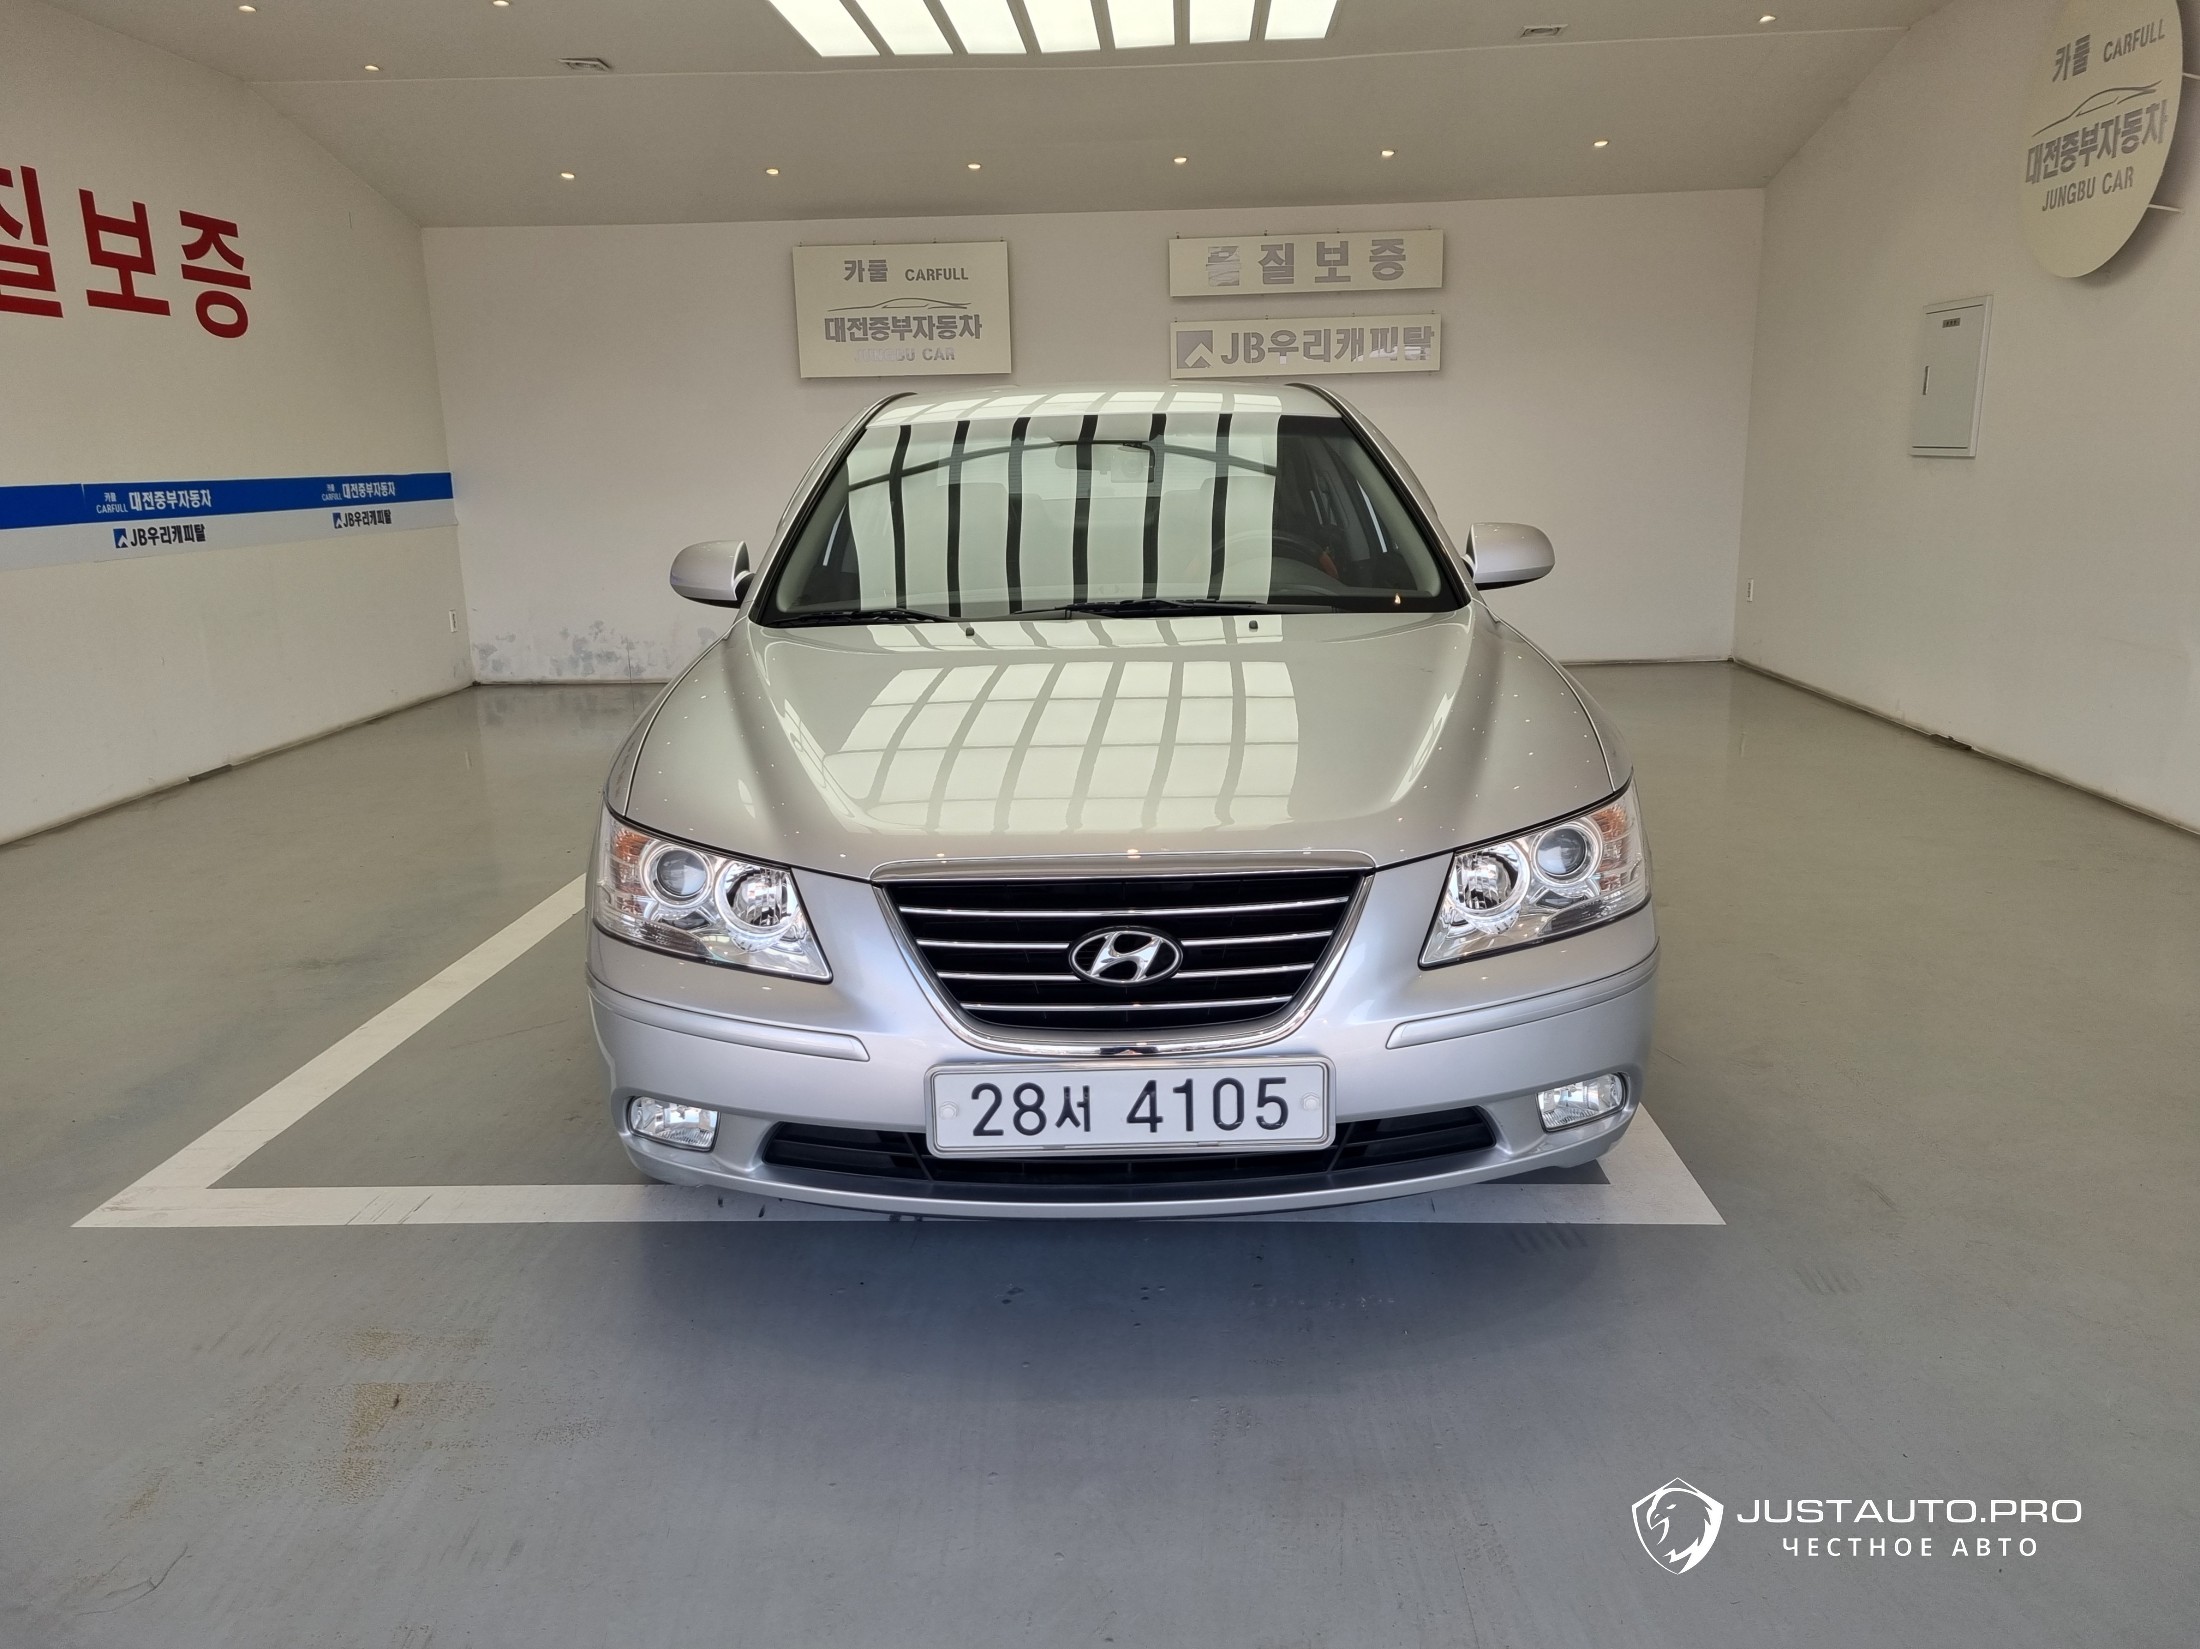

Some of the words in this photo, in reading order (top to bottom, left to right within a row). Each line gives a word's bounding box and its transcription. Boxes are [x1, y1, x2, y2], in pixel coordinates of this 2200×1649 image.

[2103, 18, 2166, 63] CARFULL
[2025, 99, 2170, 184] 대전중부자동차
[2042, 176, 2096, 212] JUNGBU
[2102, 166, 2134, 195] CAR
[905, 267, 969, 281] CARFULL
[824, 314, 982, 342] 대전중부자동차
[922, 346, 955, 361] CAR
[1220, 325, 1435, 364] JB우리캐피탈
[128, 489, 212, 512] 대전중부자동차
[342, 481, 396, 499] 대전중부자동차
[96, 503, 129, 514] CARFULL
[131, 523, 206, 547] JB우리캐피탈
[971, 1081, 1091, 1137] 28서
[1126, 1076, 1289, 1134] 4105
